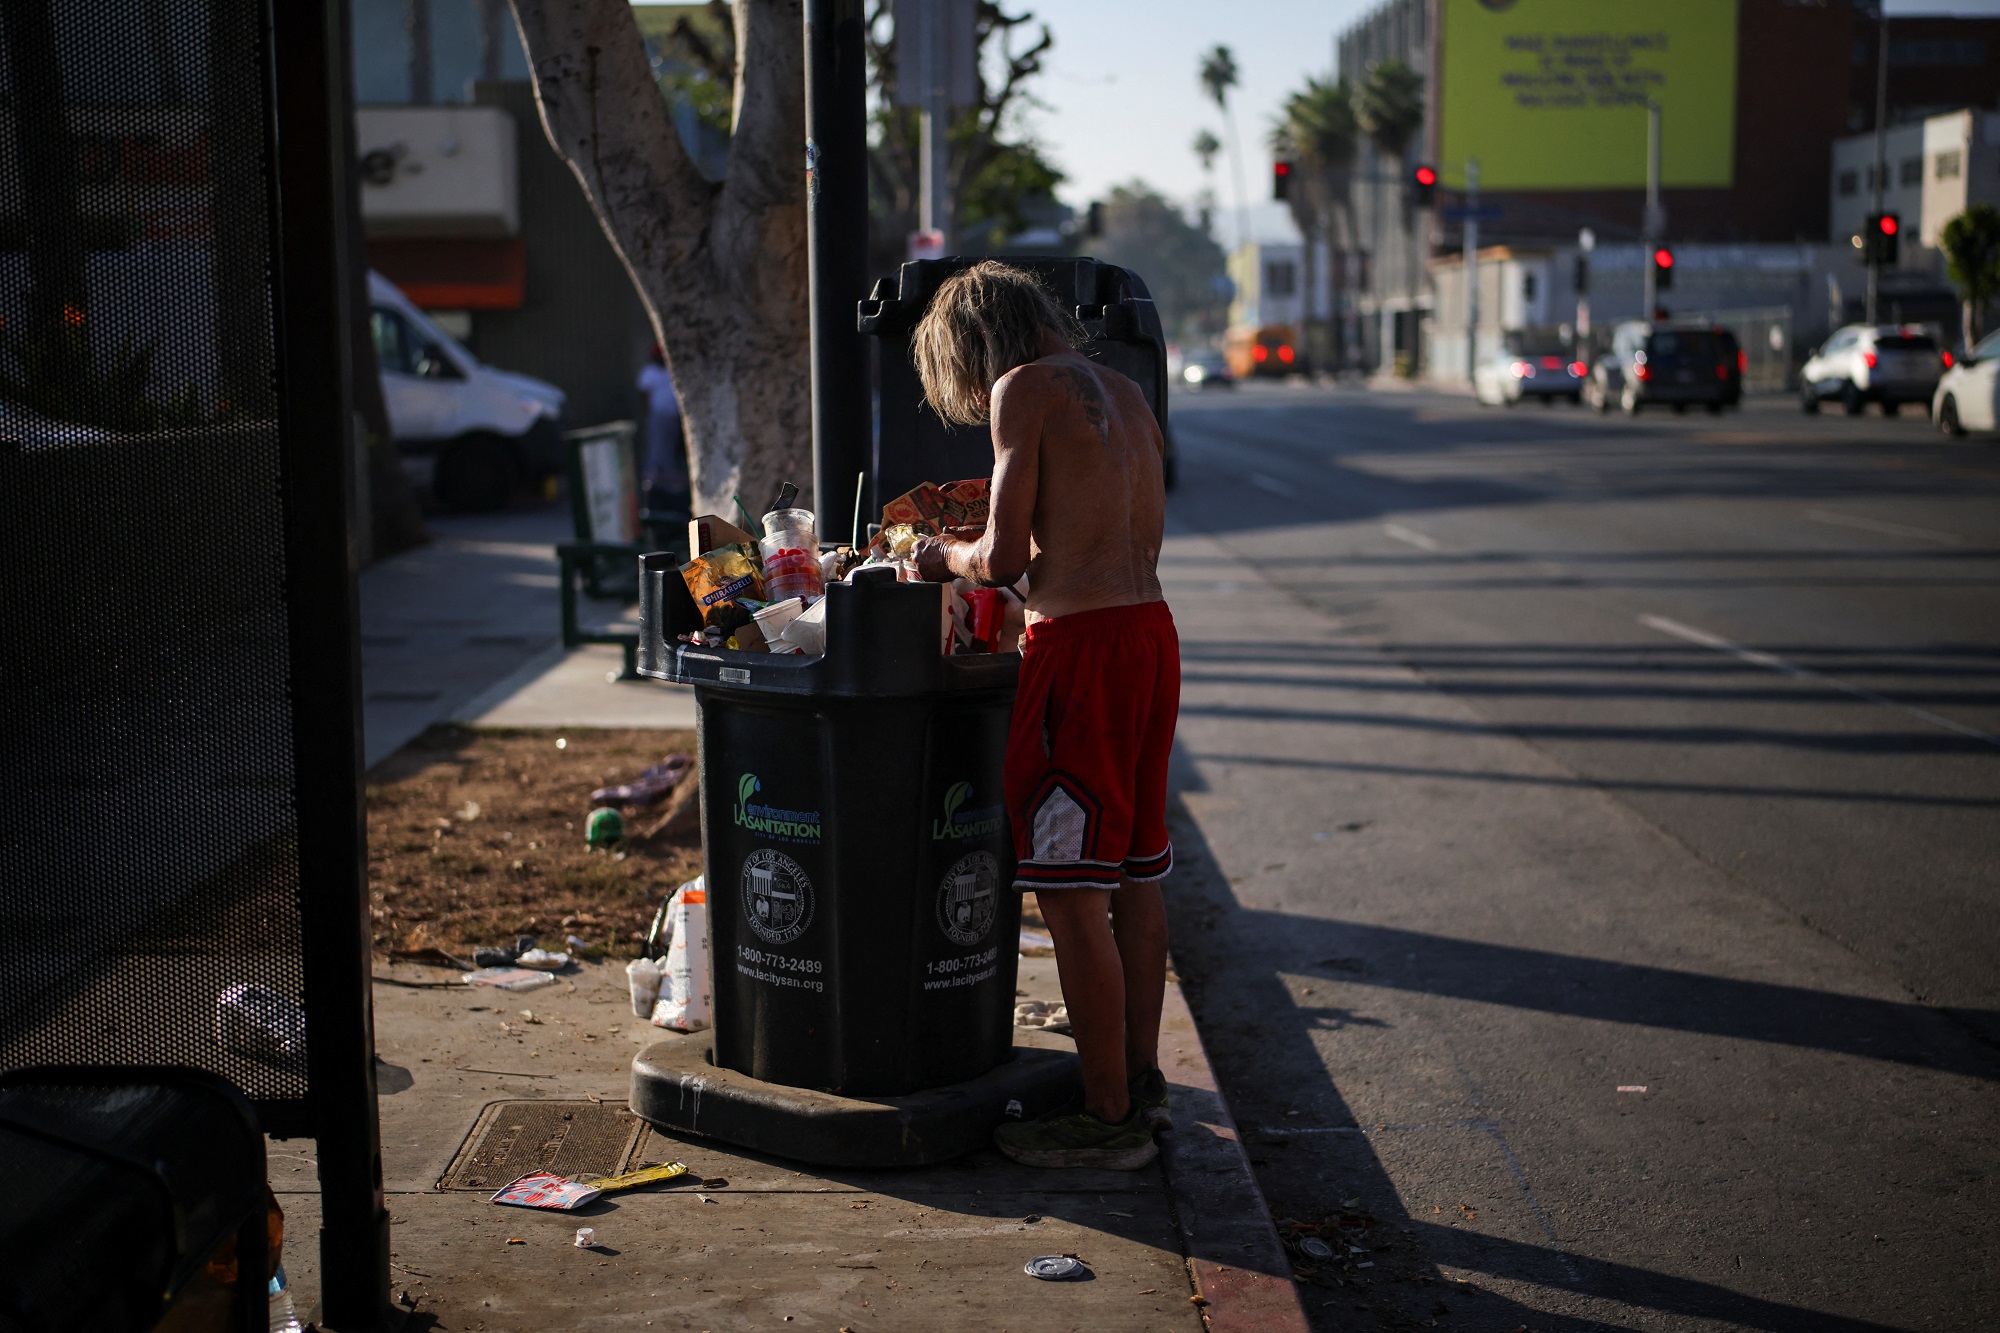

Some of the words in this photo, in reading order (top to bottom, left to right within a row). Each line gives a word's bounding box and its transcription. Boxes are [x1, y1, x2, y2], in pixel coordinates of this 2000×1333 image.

[966, 497, 989, 512] NGS
[970, 508, 989, 519] LESS
[705, 576, 753, 604] GHIRARDELLI
[747, 803, 820, 823] environment
[743, 861, 753, 877] CITY
[752, 854, 760, 863] OF
[761, 852, 775, 861] LOS
[777, 857, 808, 888] ANGELES
[943, 872, 957, 890] CITY
[956, 861, 966, 872] OF
[747, 916, 782, 941] FOUNDED
[784, 925, 803, 939] 1781
[947, 926, 979, 942] FOUNDED
[737, 944, 823, 974] 1-800-773-2489
[736, 963, 823, 993] www.lacitysan.org
